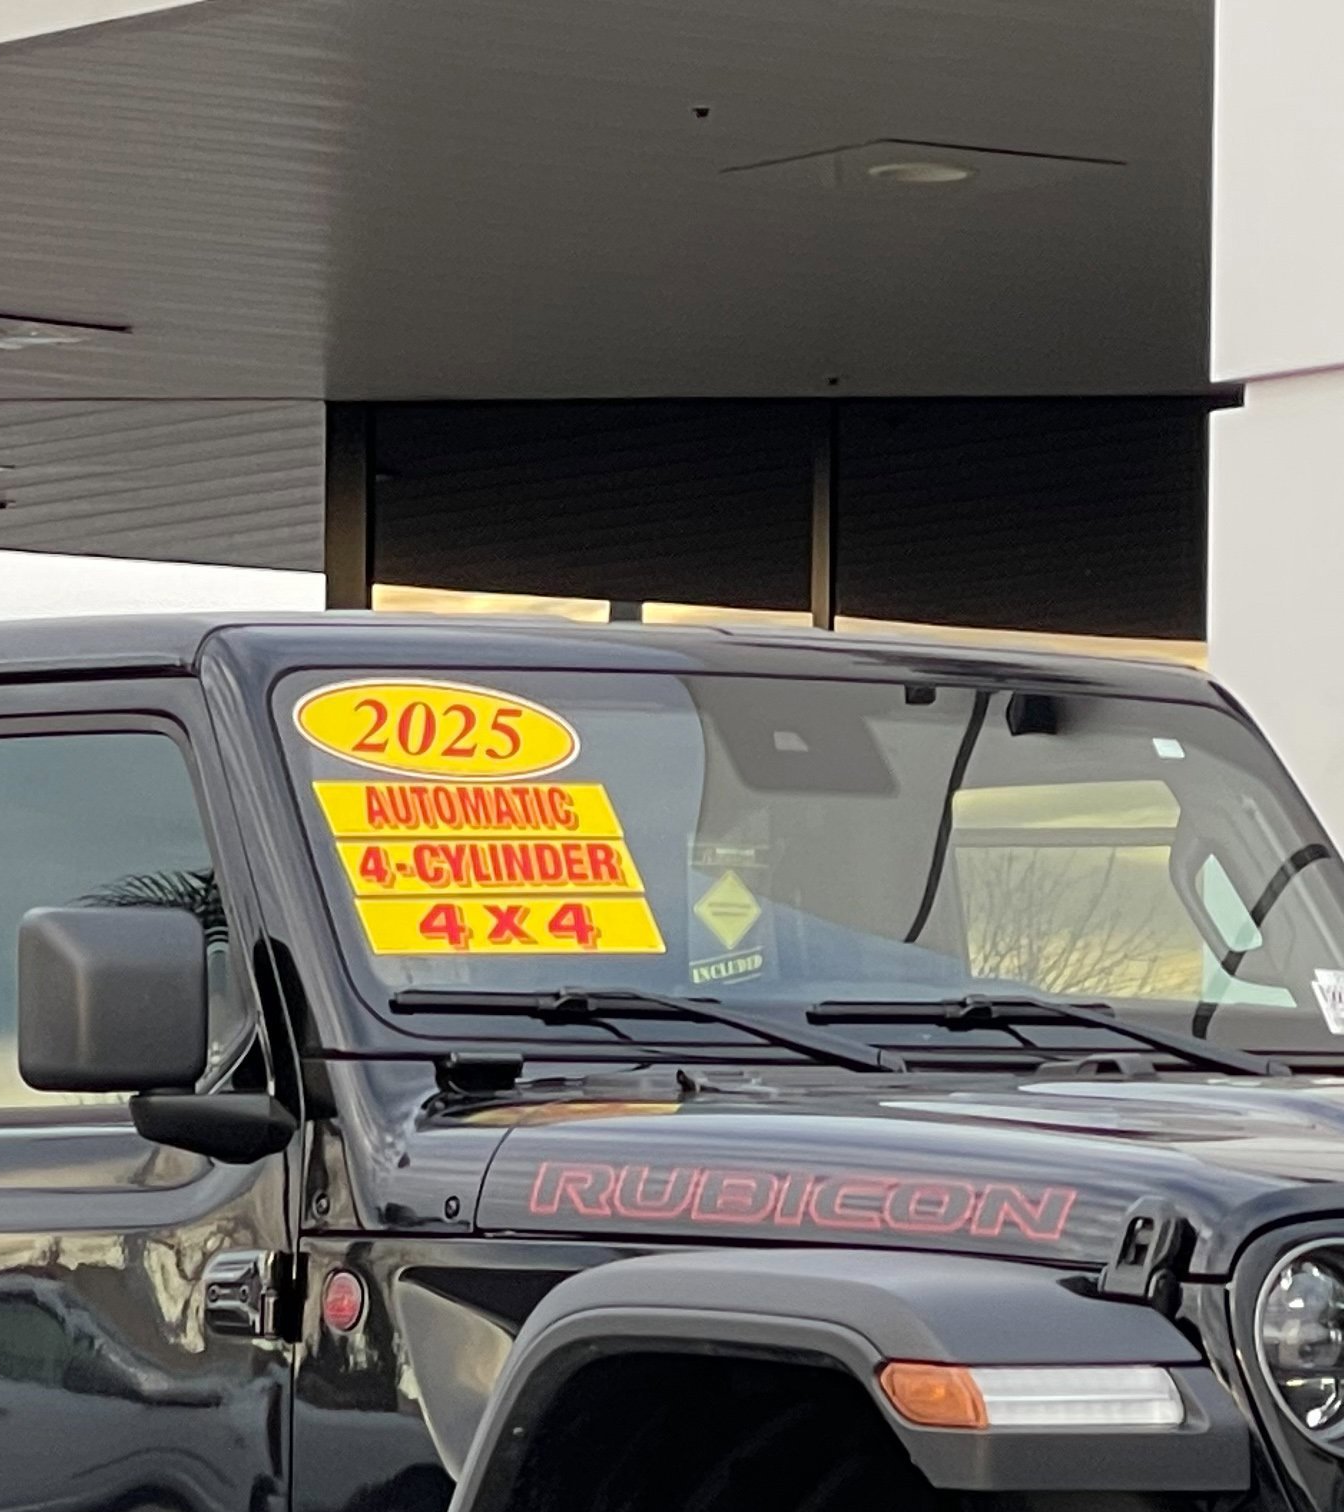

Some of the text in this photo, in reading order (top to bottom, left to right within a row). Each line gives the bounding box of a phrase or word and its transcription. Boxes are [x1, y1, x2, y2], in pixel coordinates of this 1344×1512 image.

[350, 698, 524, 760] 2025
[366, 785, 579, 831] AUTOMATIC
[358, 842, 624, 889] 4-CYLINDER
[529, 1160, 1077, 1240] RUBICON
